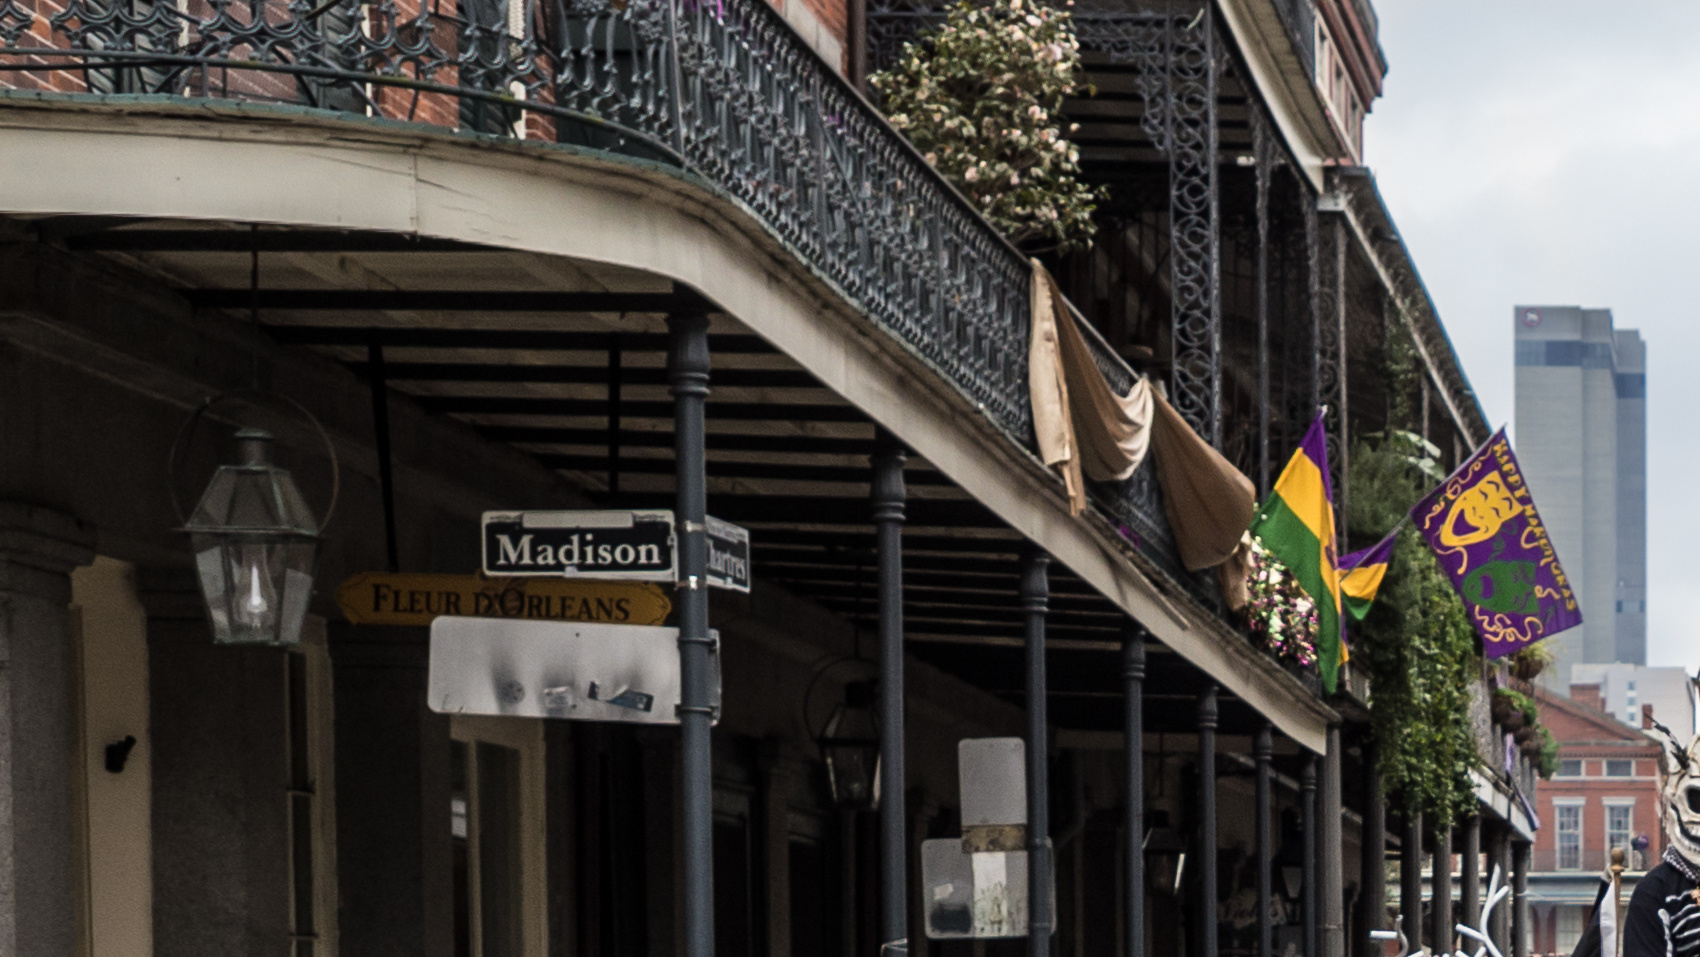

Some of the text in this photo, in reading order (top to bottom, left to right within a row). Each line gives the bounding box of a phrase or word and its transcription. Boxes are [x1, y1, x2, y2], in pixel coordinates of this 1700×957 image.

[1493, 438, 1529, 499] HAPPY
[1551, 562, 1576, 611] GRAS
[495, 532, 662, 566] Madison
[705, 537, 746, 581] hartres
[371, 583, 461, 615] FLEUR
